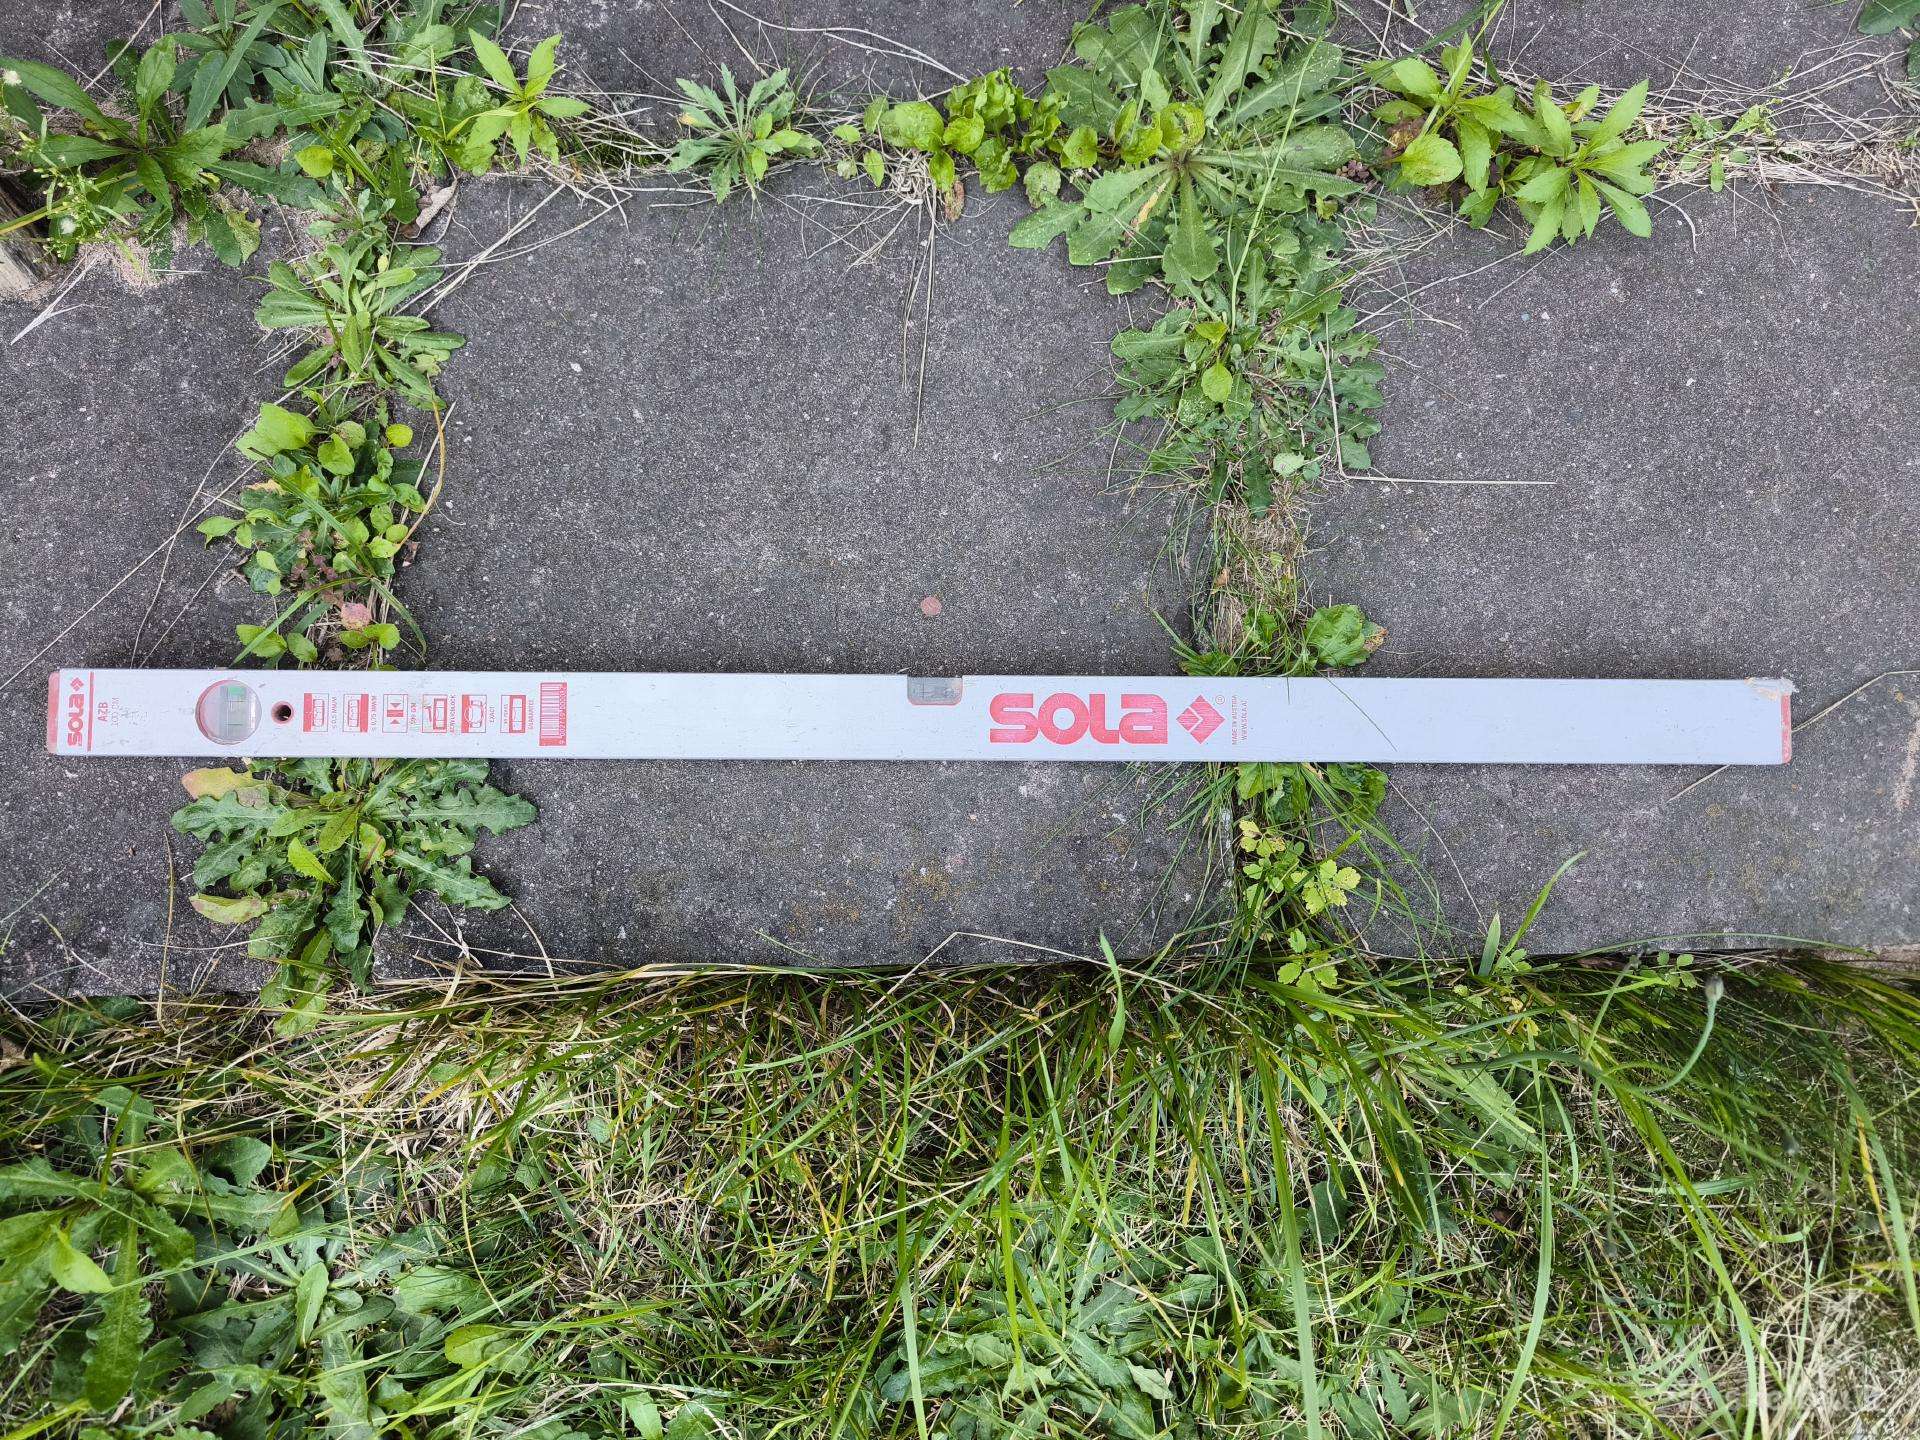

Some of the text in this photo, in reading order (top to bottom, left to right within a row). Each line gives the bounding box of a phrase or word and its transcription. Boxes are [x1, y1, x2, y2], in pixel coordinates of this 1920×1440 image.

[67, 693, 85, 747] SOLA
[97, 701, 109, 722] AZB
[990, 692, 1168, 745] SOLA
